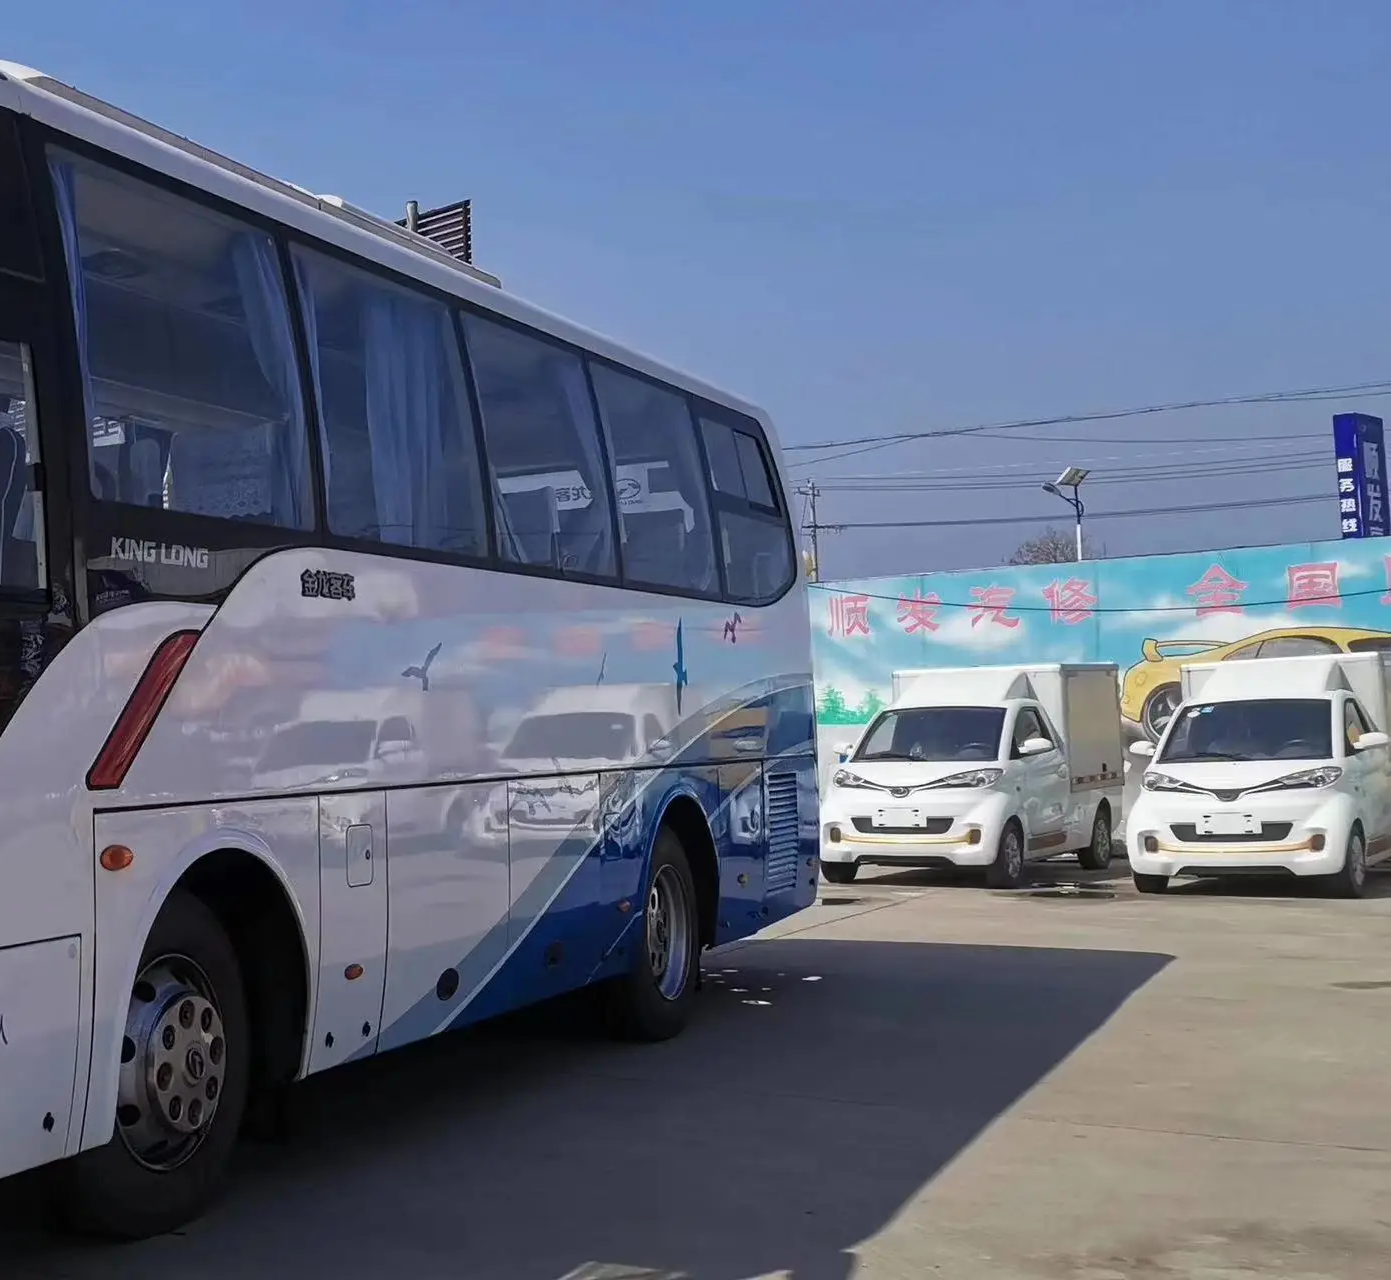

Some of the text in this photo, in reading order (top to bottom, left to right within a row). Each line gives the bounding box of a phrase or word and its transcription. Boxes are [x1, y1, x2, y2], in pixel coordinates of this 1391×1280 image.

[1337, 458, 1358, 533] 服务热线
[111, 536, 209, 569] KING LONG
[828, 553, 1391, 638] 顺发汽修 全国
